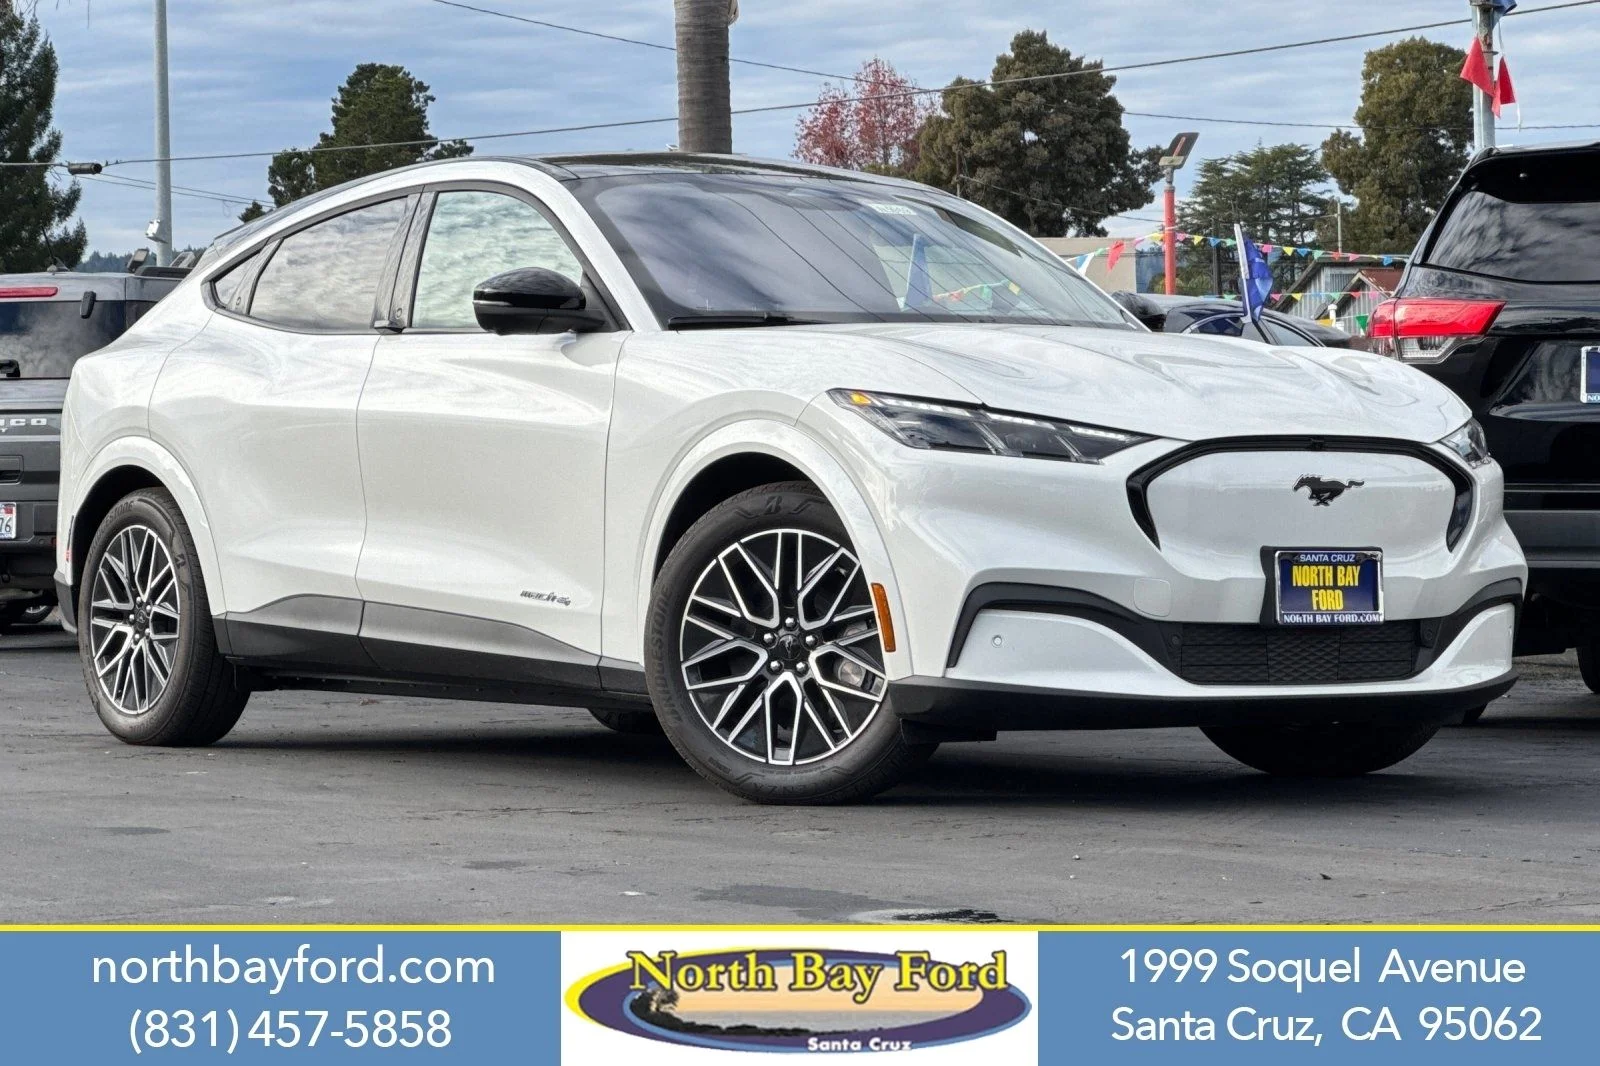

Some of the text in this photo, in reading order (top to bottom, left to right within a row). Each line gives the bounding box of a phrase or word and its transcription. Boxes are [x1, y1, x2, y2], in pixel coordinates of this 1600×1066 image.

[0, 418, 47, 426] CO
[1300, 554, 1355, 562] SANTA CRUZ
[1292, 565, 1361, 587] NORTH BAY
[1311, 589, 1344, 611] FORD
[1283, 614, 1313, 623] NORTH
[1316, 614, 1332, 623] BAY
